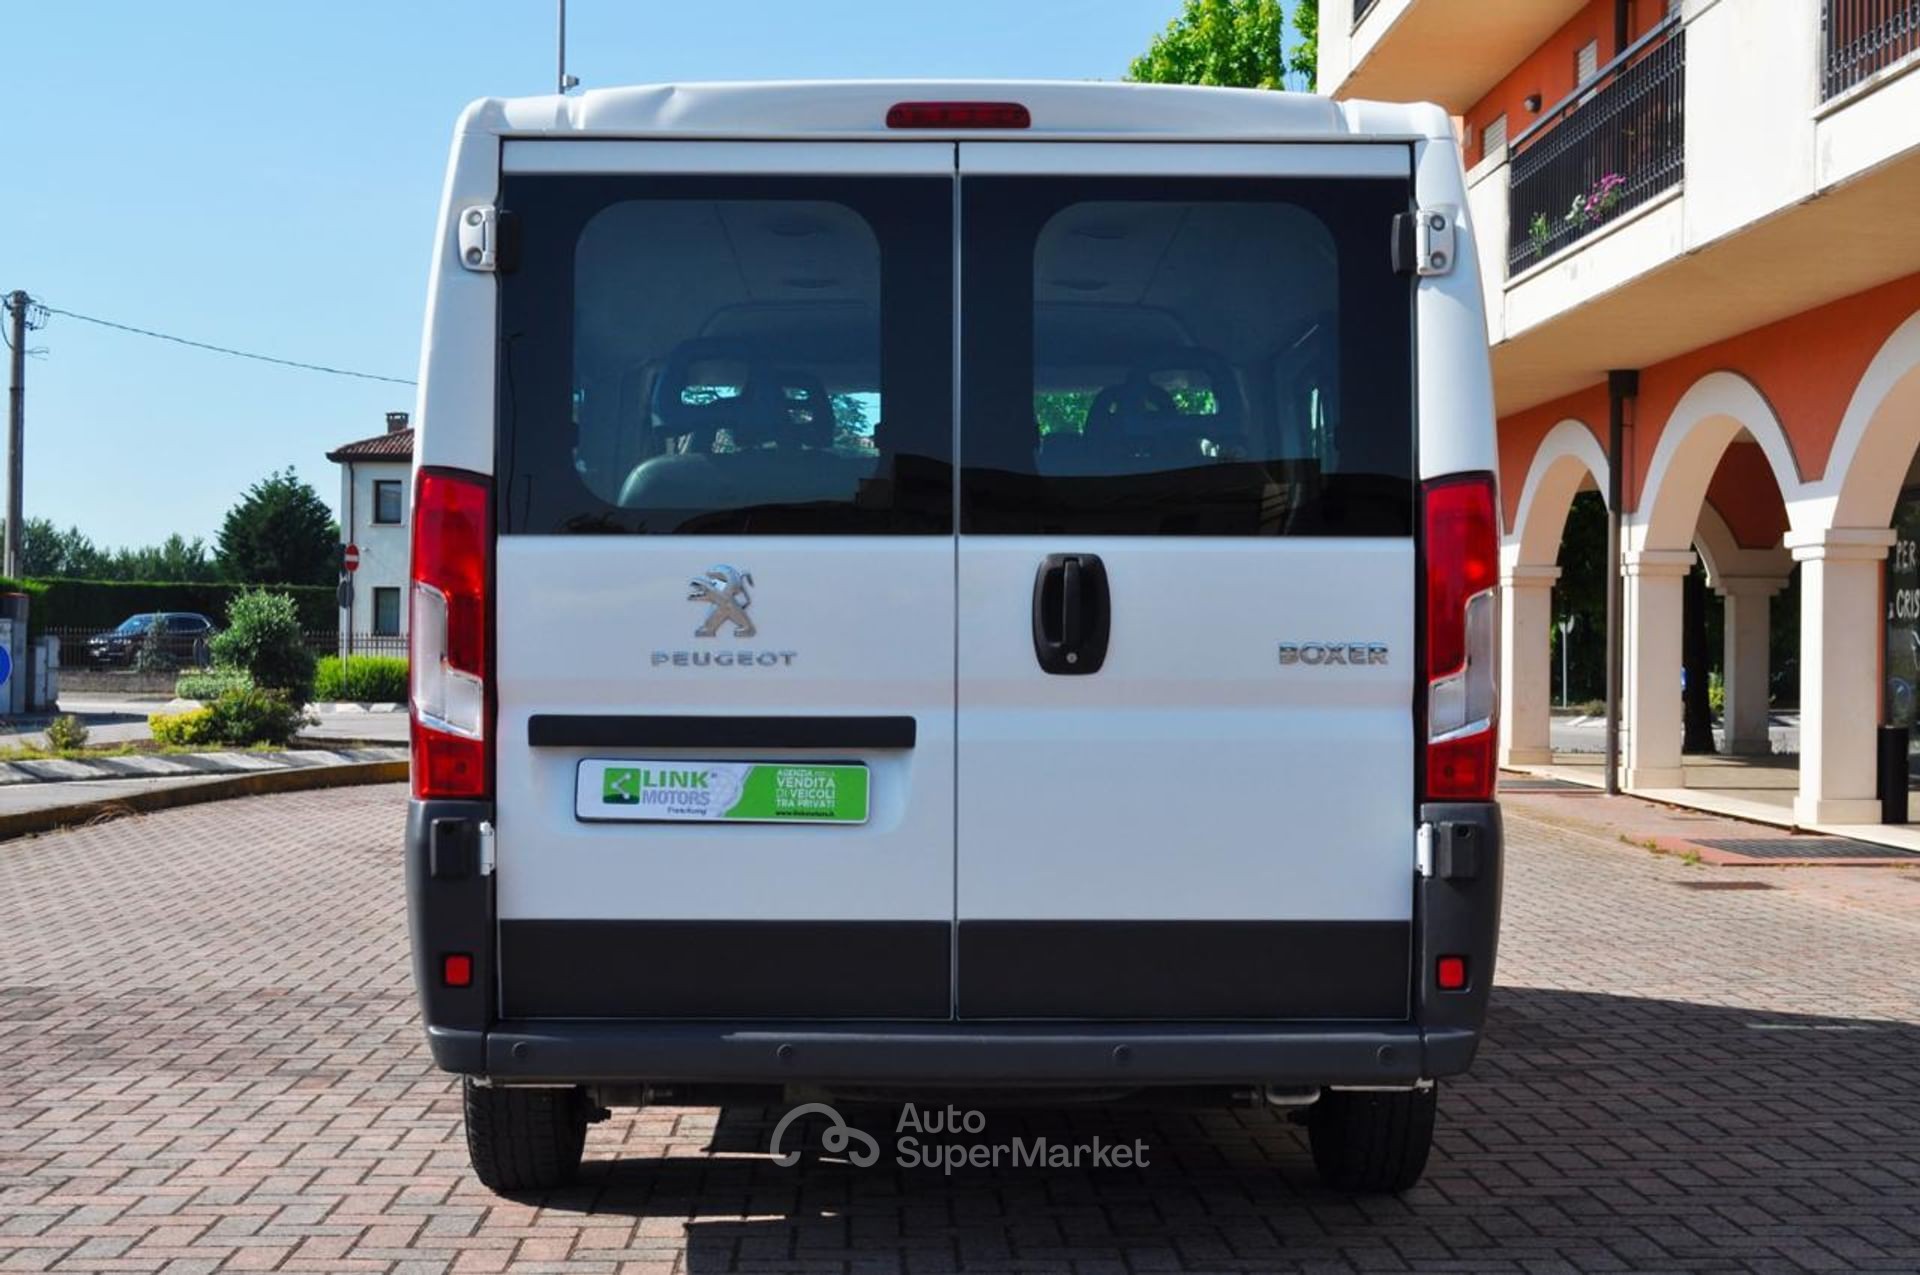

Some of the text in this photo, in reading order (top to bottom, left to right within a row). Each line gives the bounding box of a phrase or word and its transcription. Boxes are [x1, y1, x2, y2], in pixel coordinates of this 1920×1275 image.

[650, 651, 798, 667] PEUGEOT
[1279, 641, 1389, 665] BOXER
[642, 770, 709, 788] LINK
[776, 776, 836, 789] VENDITA
[642, 789, 711, 806] MOTORS
[790, 788, 836, 799] VEICOLI
[776, 799, 836, 809] TRA PRIVATI
